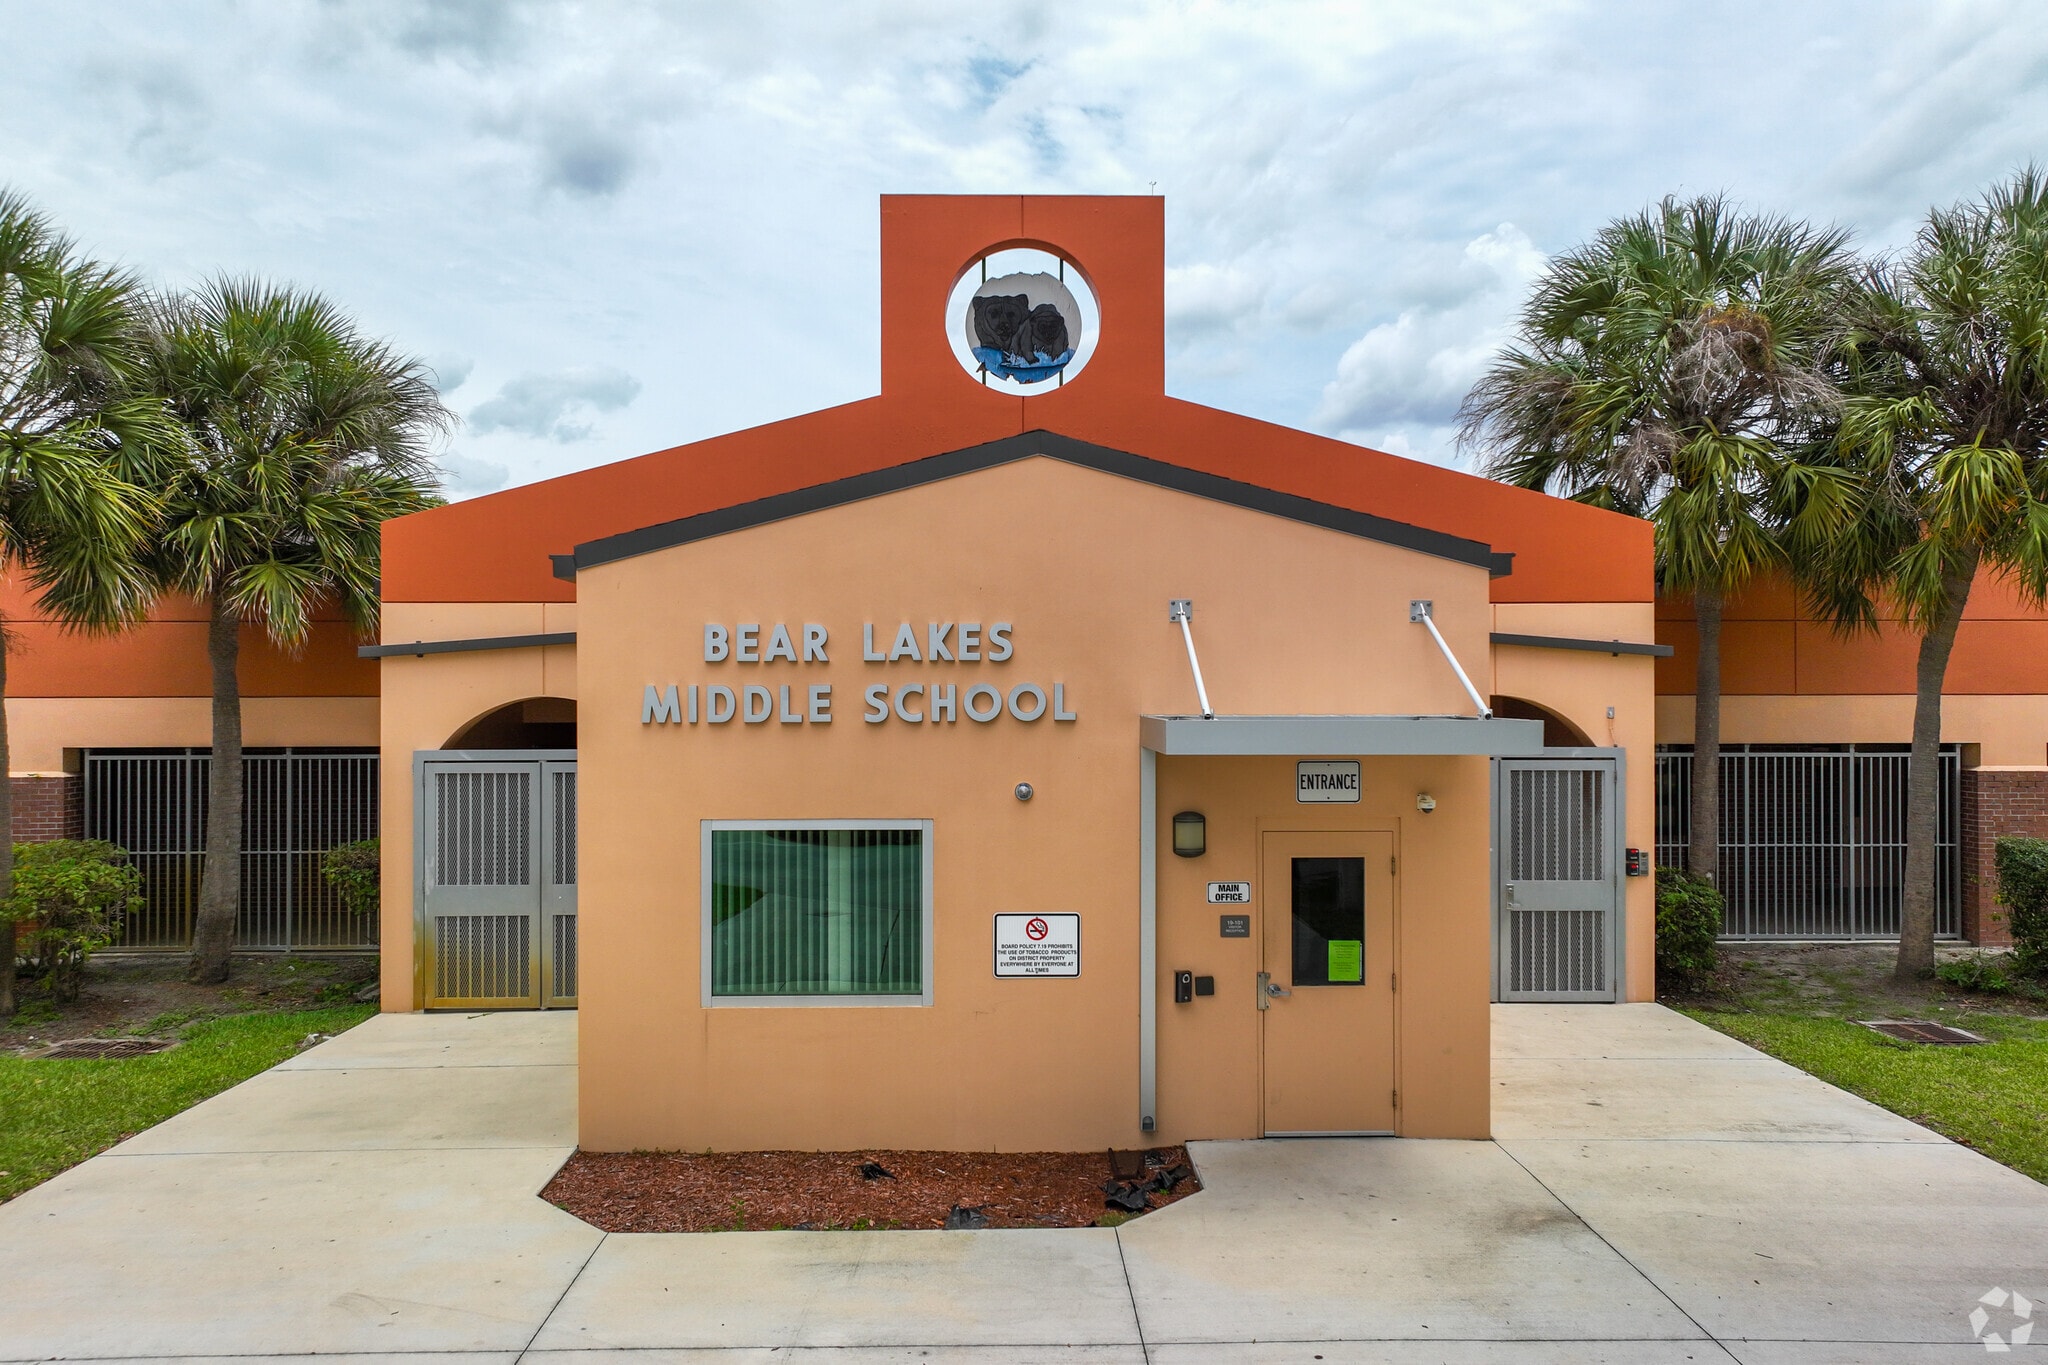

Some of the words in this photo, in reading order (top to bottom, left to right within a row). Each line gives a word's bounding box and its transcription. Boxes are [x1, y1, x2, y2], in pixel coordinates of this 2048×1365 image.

[704, 623, 829, 662] BEAR
[863, 623, 1013, 662] LAKES
[641, 684, 832, 724] MIDDLE
[864, 682, 1077, 723] SCHOOL
[1300, 774, 1357, 790] ENTRANCE
[1218, 884, 1240, 892] MAIN
[1215, 893, 1243, 901] OFFICE
